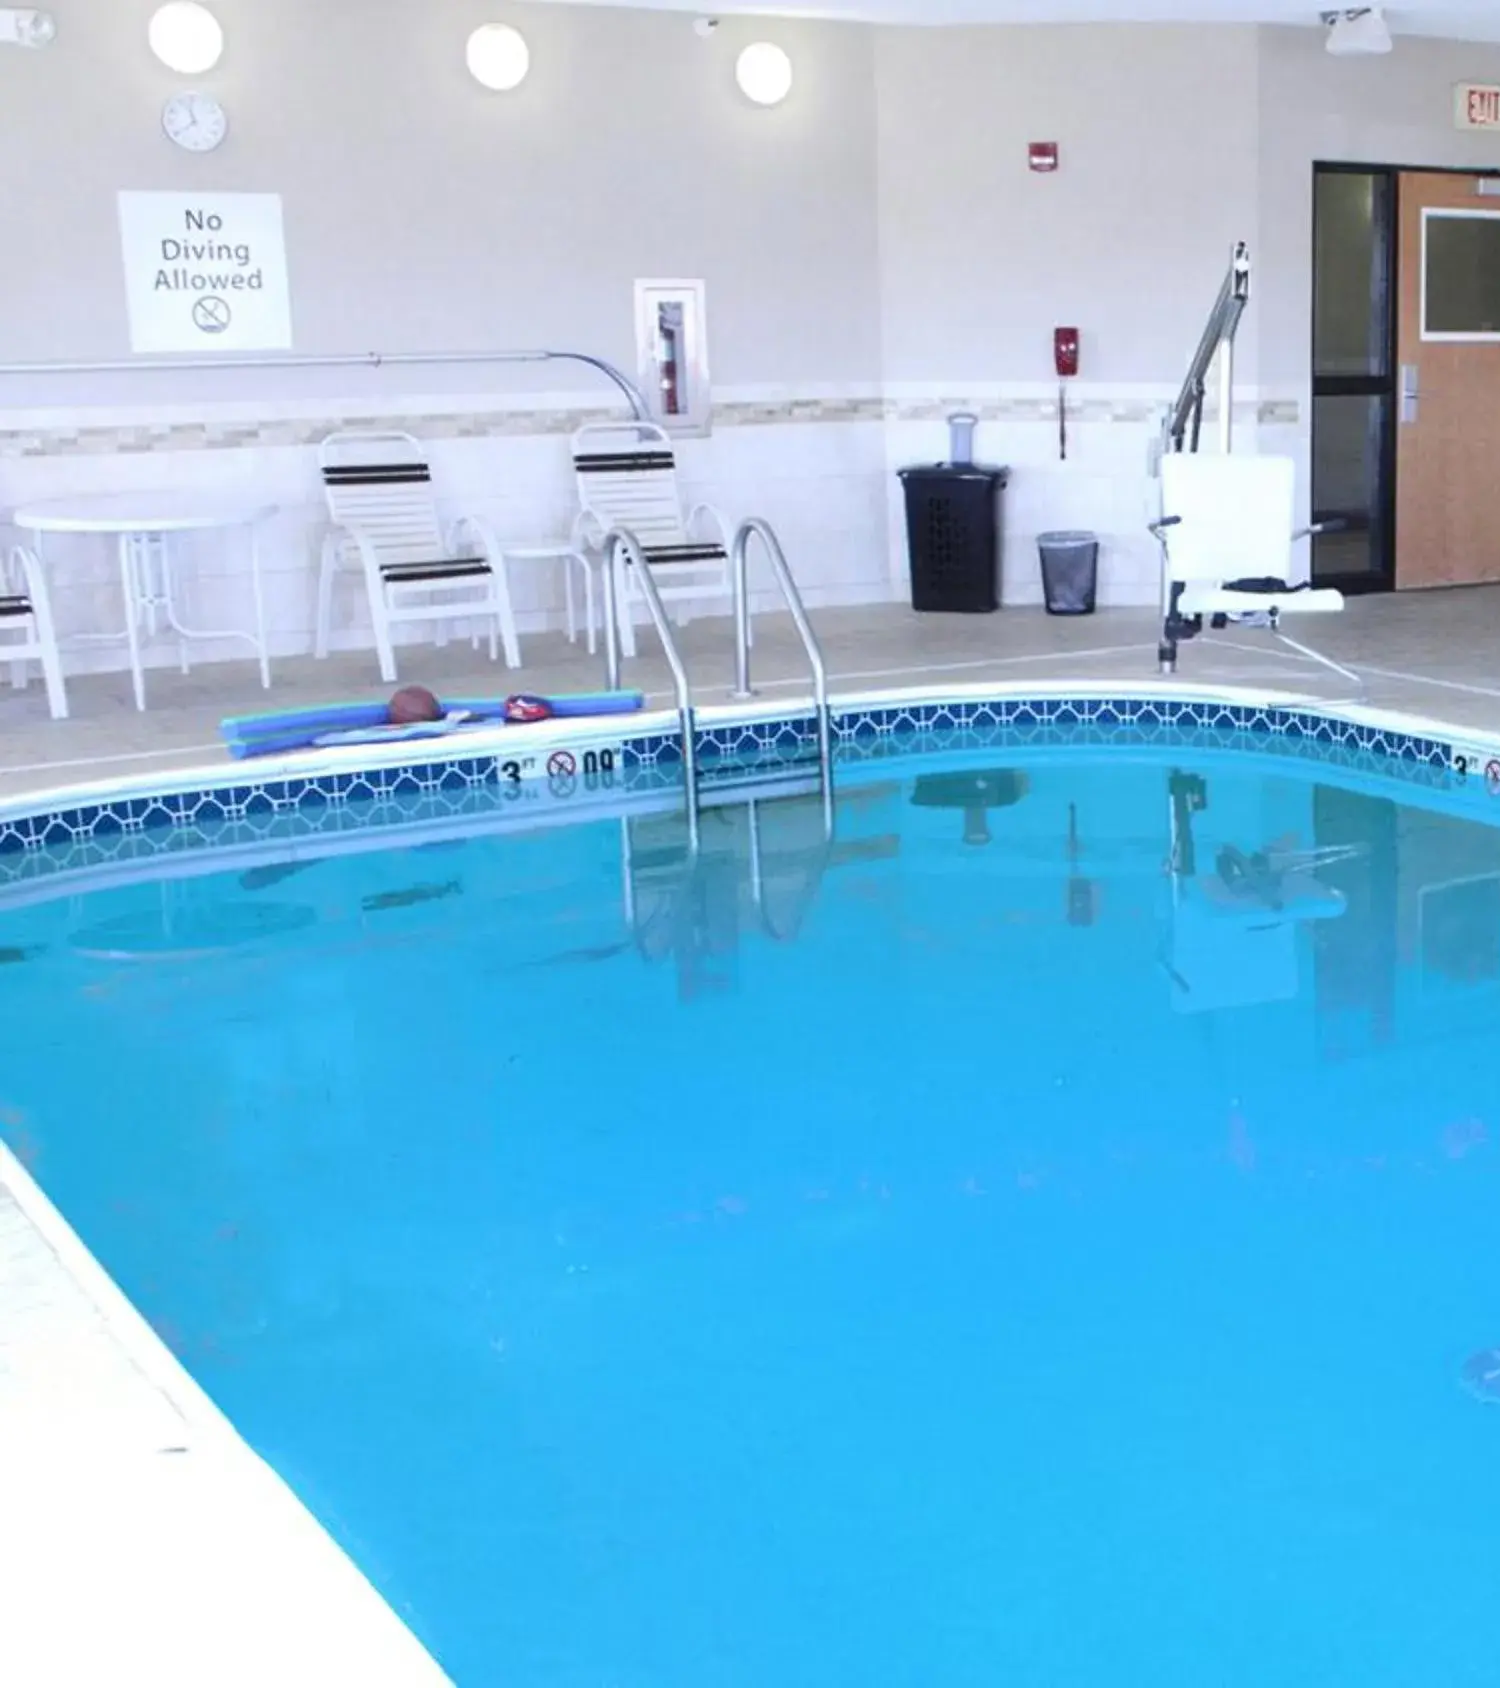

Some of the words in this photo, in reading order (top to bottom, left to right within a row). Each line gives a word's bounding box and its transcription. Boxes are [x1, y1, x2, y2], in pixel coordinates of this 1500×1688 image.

[1468, 90, 1500, 124] EXIT
[185, 209, 222, 231] No
[161, 238, 250, 267] Diving
[154, 268, 263, 291] Allowed
[502, 761, 520, 783] 3
